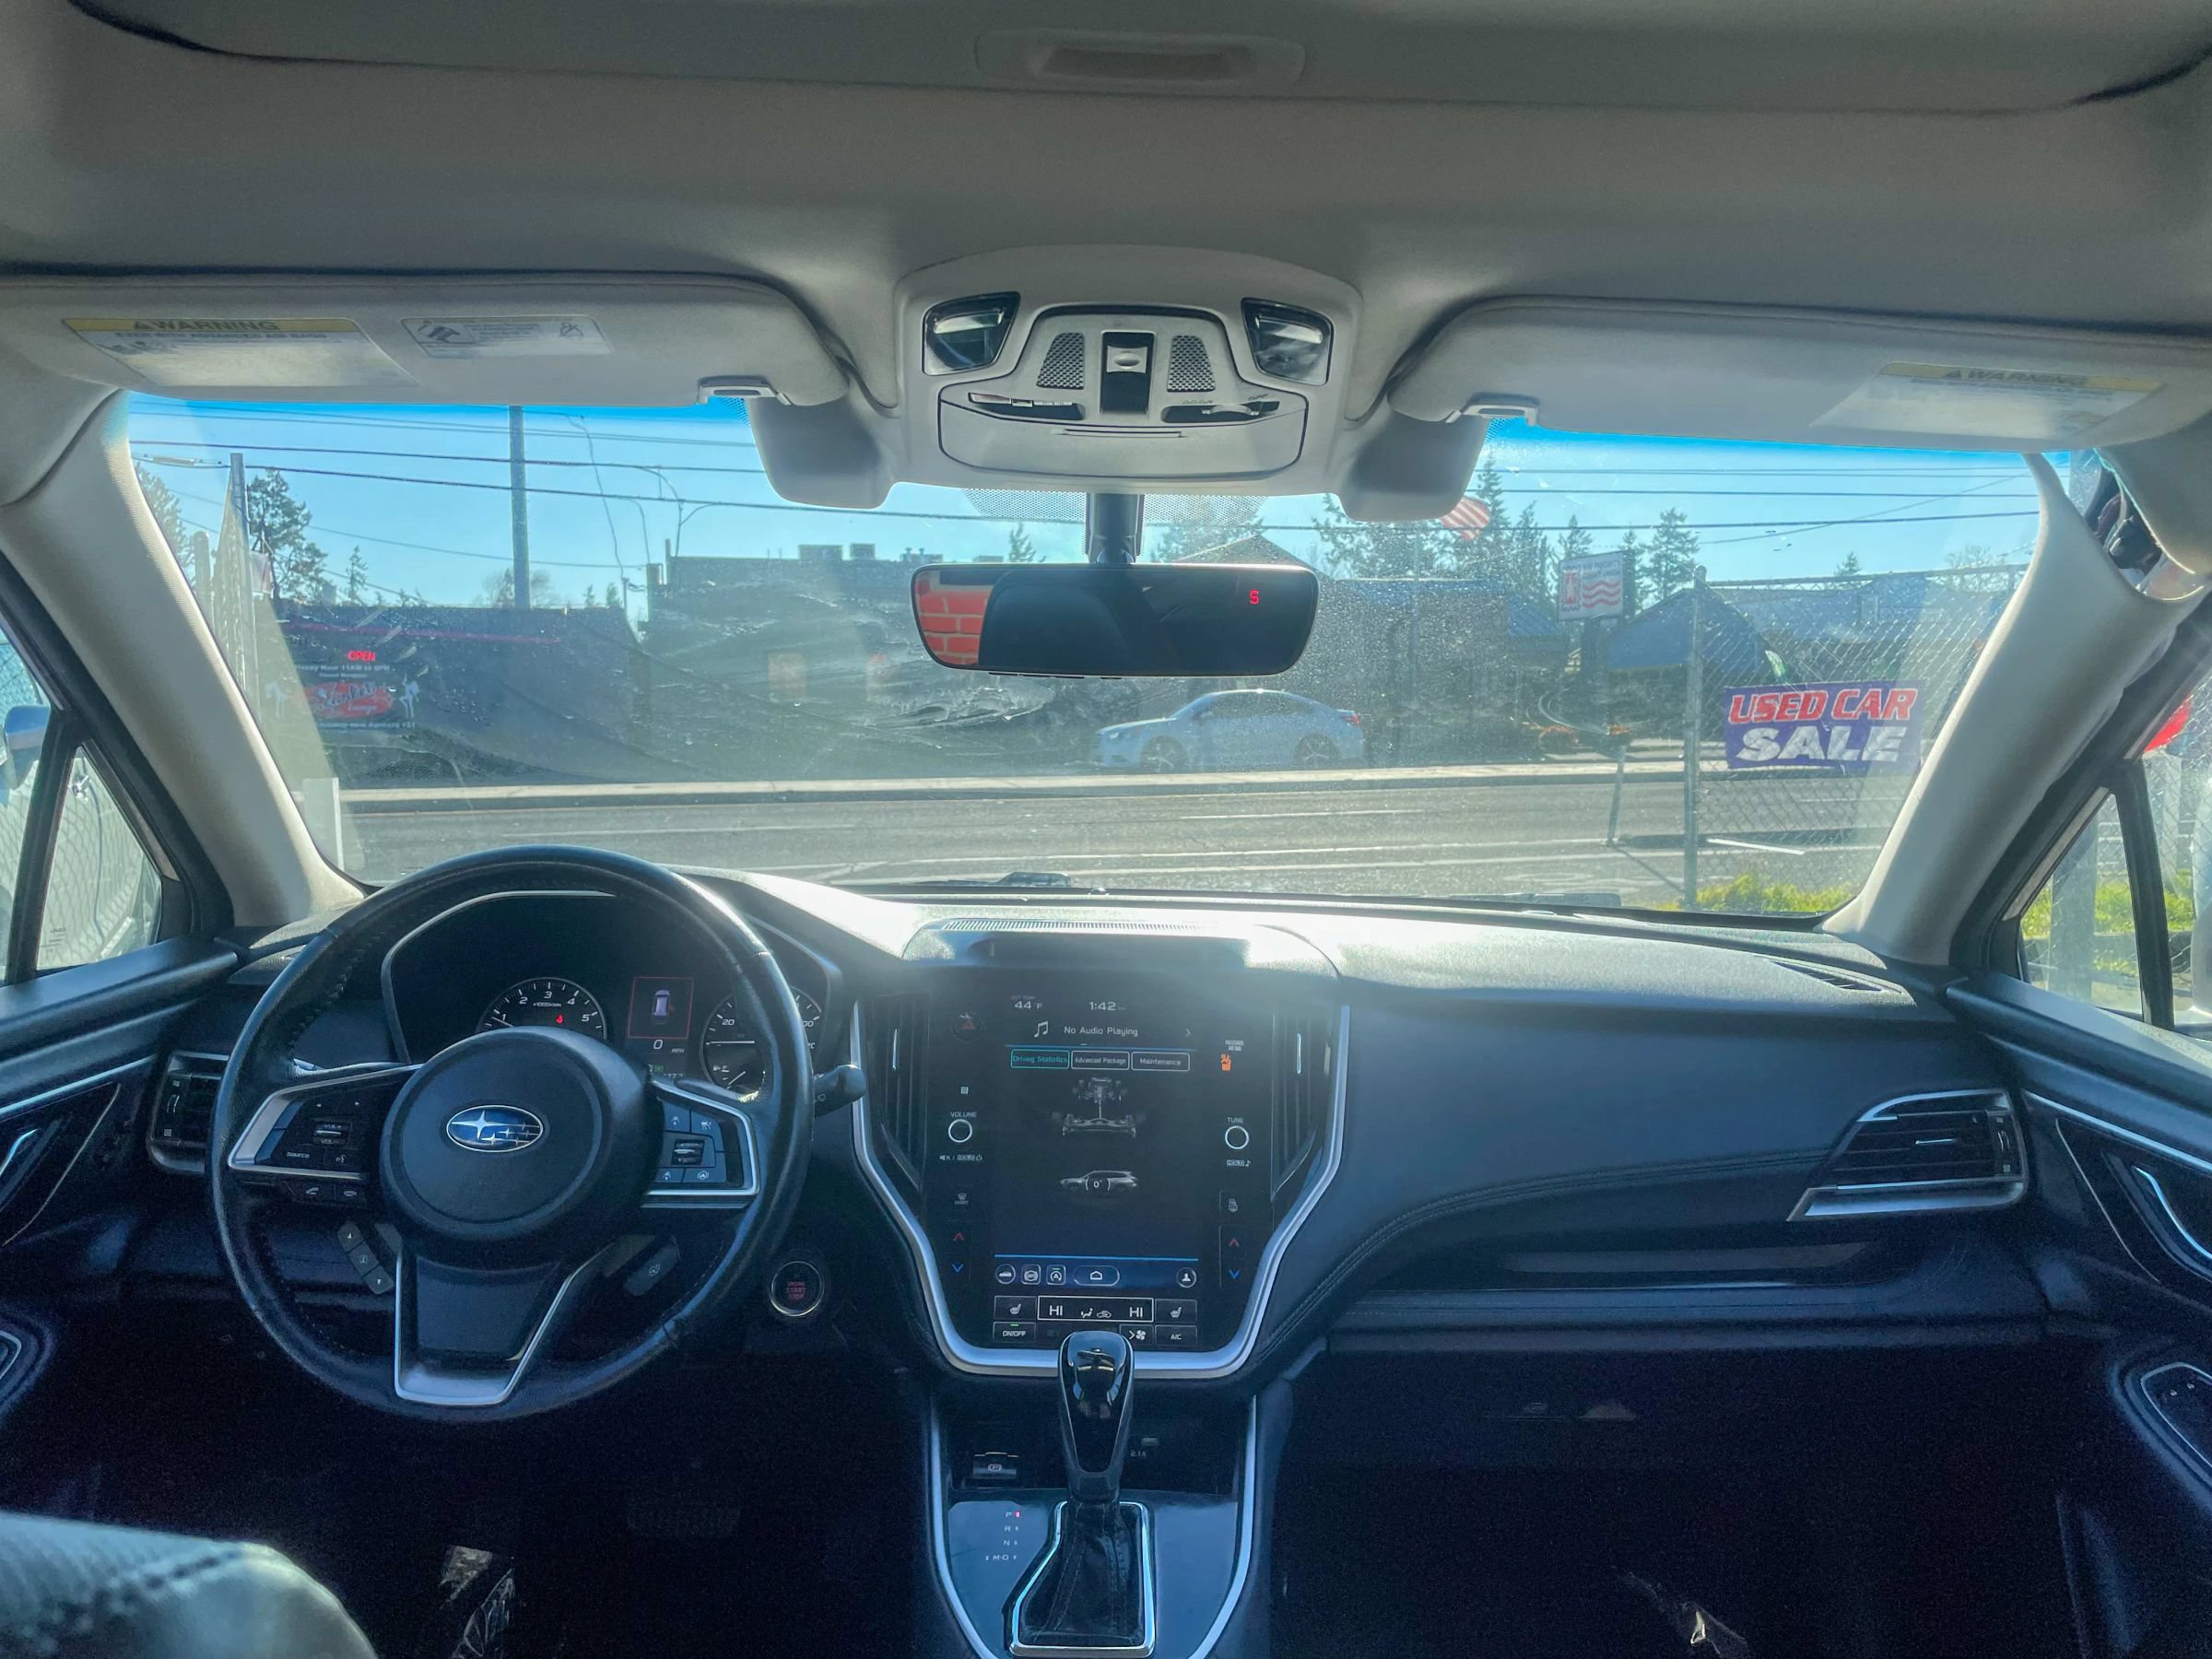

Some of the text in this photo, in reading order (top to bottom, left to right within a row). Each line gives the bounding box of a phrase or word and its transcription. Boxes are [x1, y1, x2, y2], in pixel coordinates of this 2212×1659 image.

[152, 321, 280, 331] WARNING
[1969, 369, 2088, 385] WARNING
[347, 650, 376, 661] OPEN
[1728, 688, 1918, 724] USED CAR
[1736, 726, 1908, 762] SALE
[544, 991, 552, 999] 3
[519, 996, 528, 1005] 2
[567, 997, 575, 1006] 4
[1014, 1001, 1031, 1009] 44
[1088, 1001, 1116, 1011] 1:42
[582, 1014, 590, 1022] 5
[1064, 1026, 1138, 1038] No Audio Playing
[653, 1039, 664, 1050] 0
[1013, 1055, 1067, 1065] Driving Statistics
[1075, 1056, 1126, 1066] Advanced Package
[1139, 1058, 1182, 1066] Maintenance
[1049, 1304, 1063, 1316] HI
[1129, 1306, 1144, 1318] HI
[1002, 1329, 1027, 1337] ON/OFF
[1171, 1333, 1182, 1341] A/C
